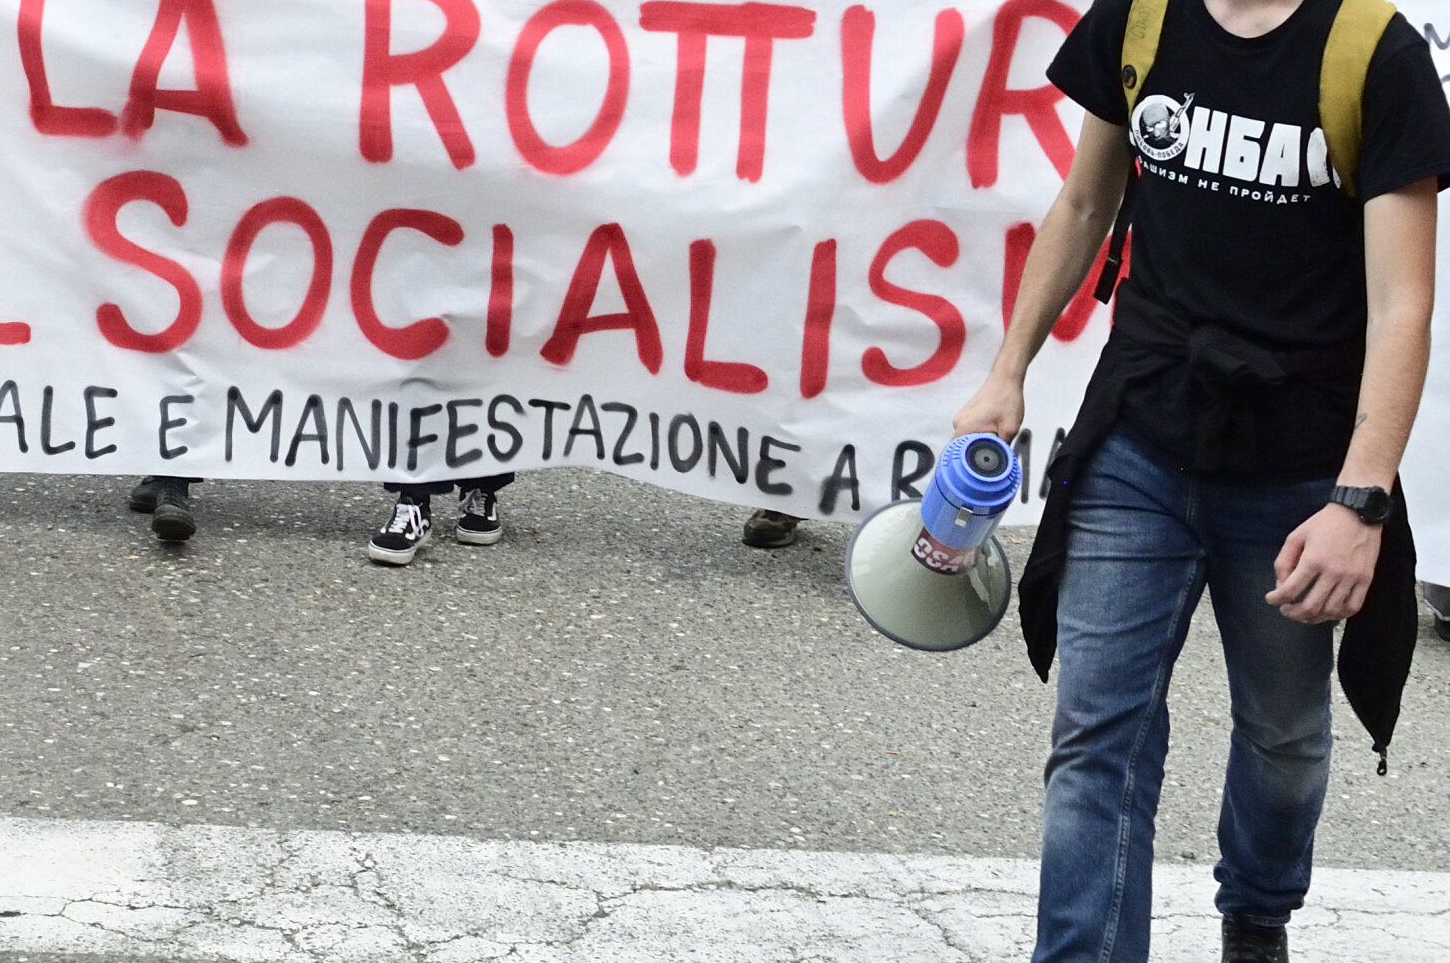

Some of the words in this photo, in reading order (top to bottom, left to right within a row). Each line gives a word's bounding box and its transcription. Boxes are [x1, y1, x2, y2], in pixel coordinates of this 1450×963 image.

[1198, 180, 1220, 191] НЕ
[1229, 186, 1311, 205] ПРОЙДЕТ
[83, 170, 1132, 398] SOCIALIS
[158, 394, 195, 460] E
[225, 388, 801, 497] MANIFESTAZIONE
[817, 443, 861, 516] A
